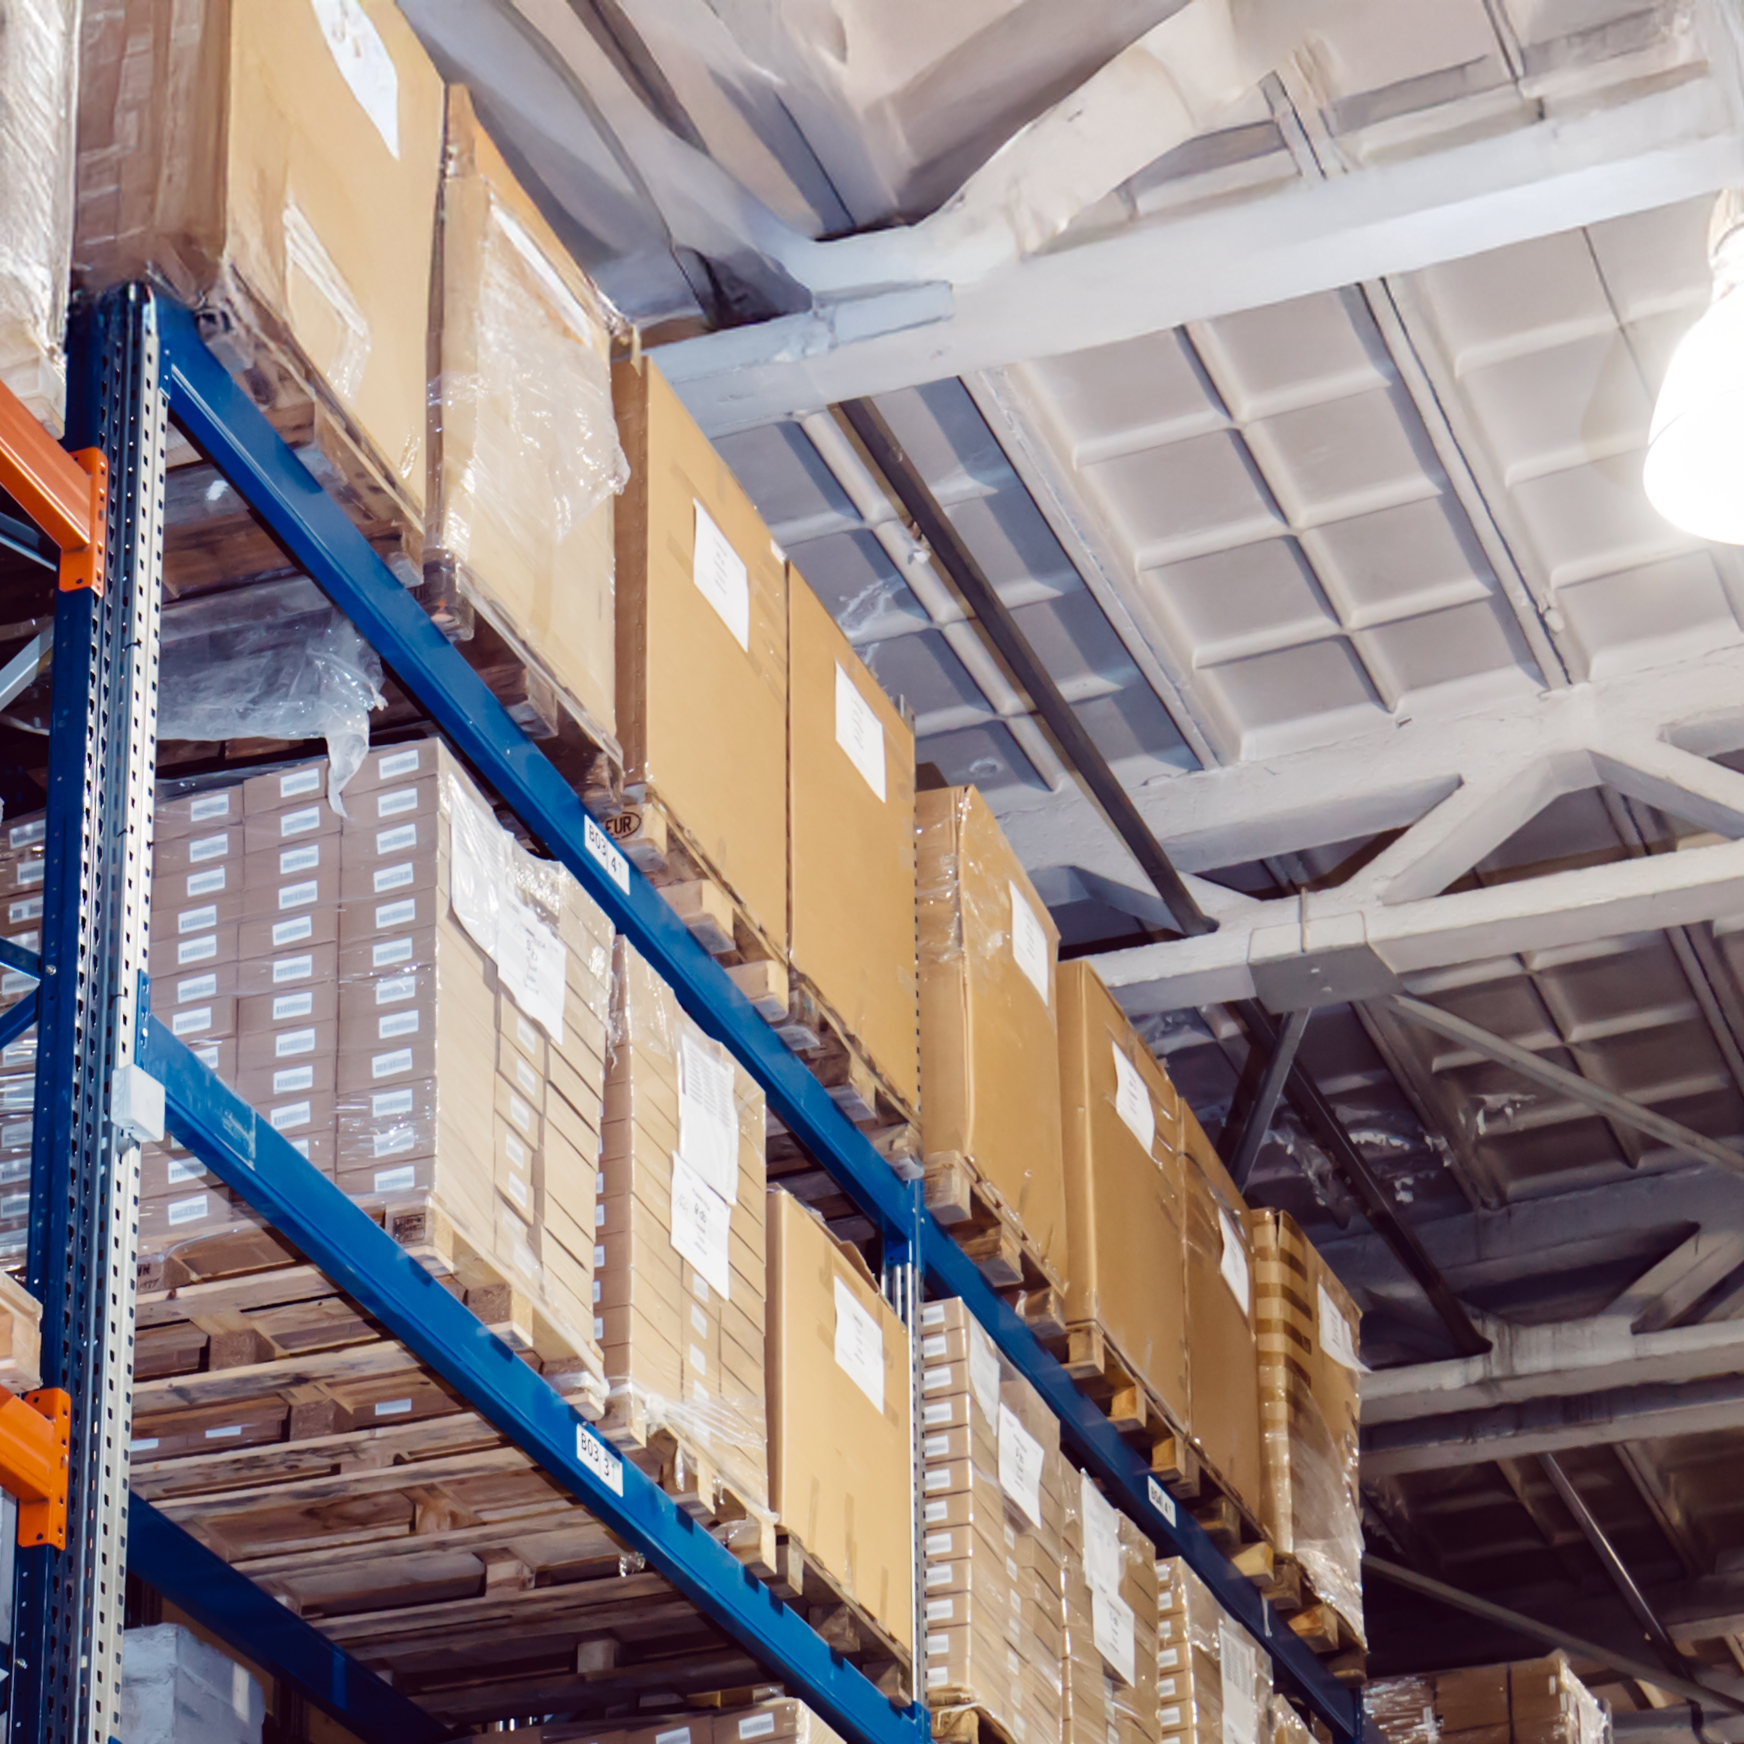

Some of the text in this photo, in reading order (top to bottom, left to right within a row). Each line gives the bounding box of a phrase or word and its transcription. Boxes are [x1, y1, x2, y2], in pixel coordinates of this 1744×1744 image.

[588, 824, 617, 873] B03 4
[605, 816, 632, 837] EUR
[581, 1432, 610, 1477] B03 3
